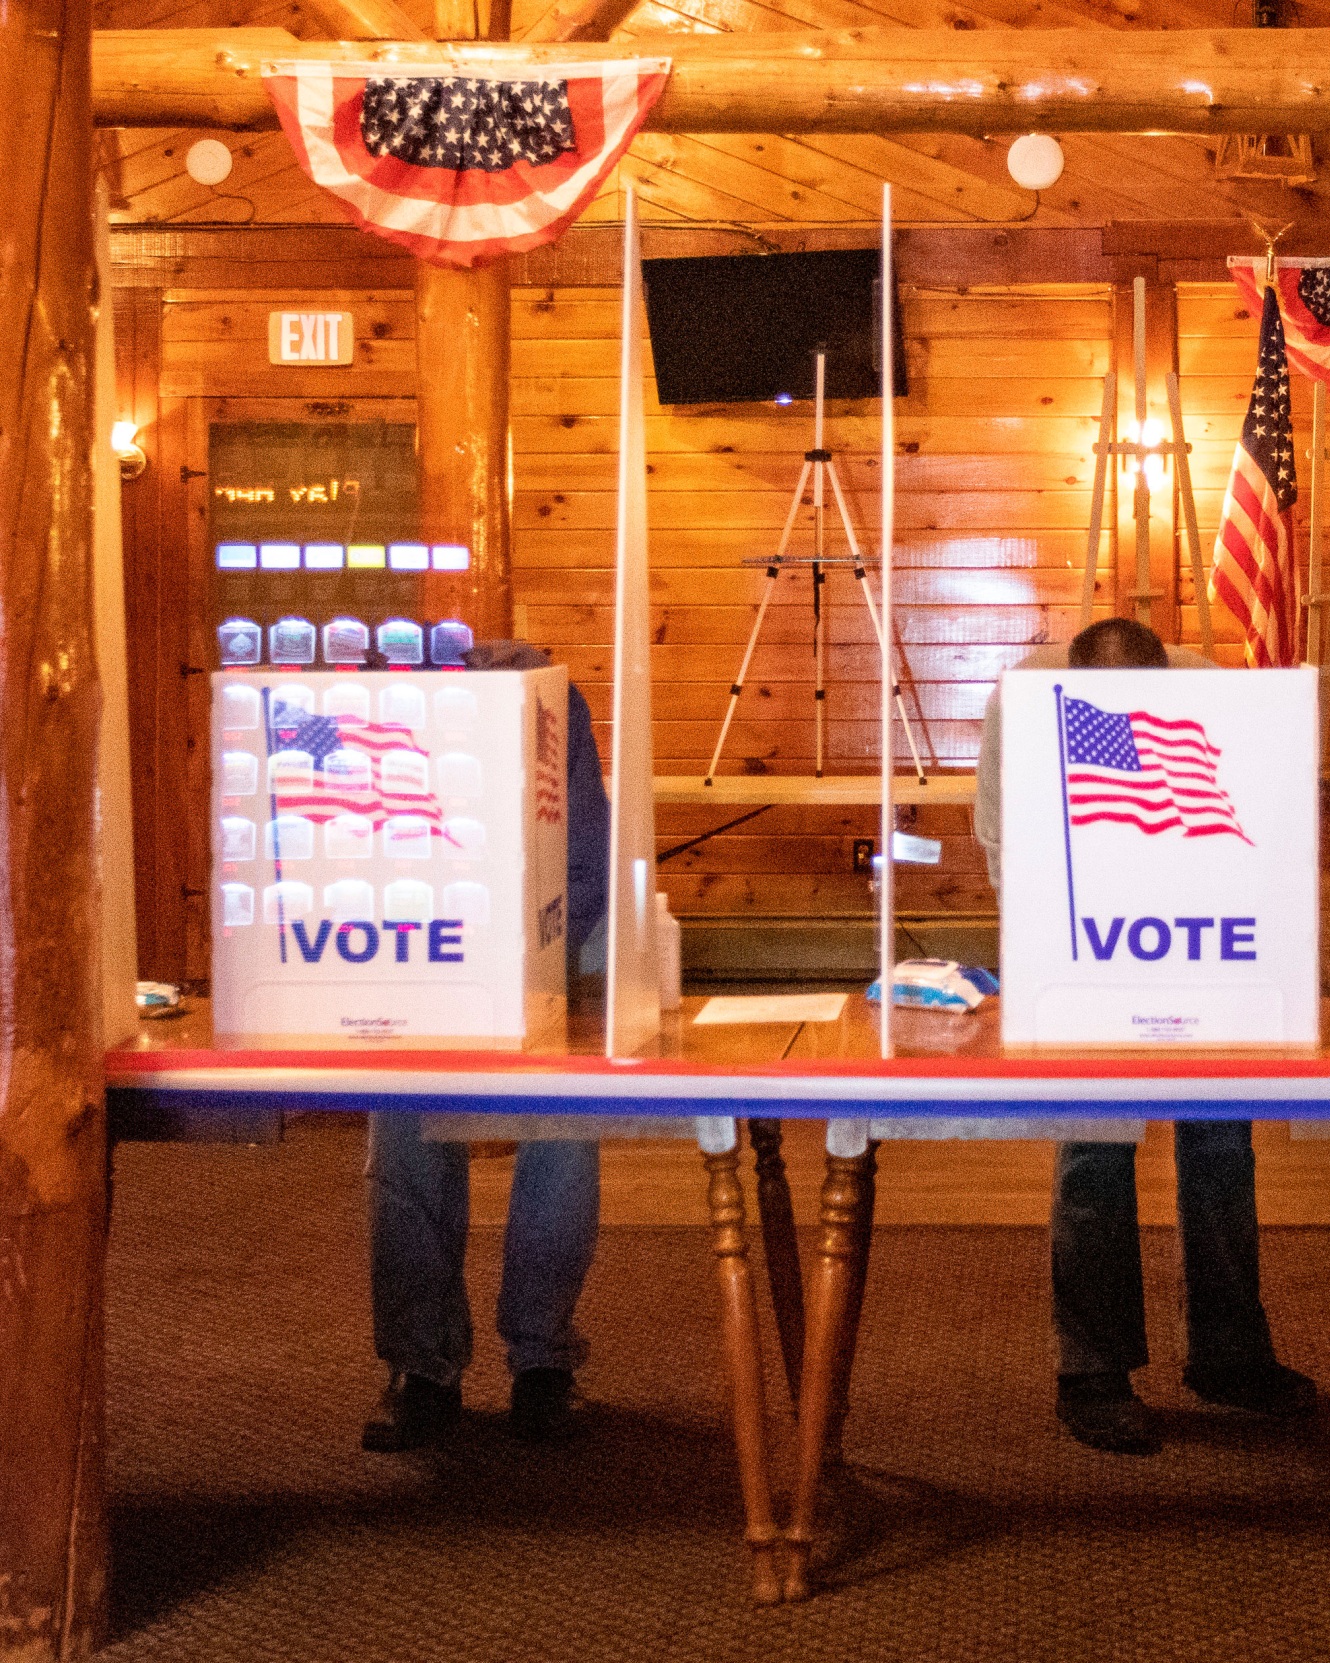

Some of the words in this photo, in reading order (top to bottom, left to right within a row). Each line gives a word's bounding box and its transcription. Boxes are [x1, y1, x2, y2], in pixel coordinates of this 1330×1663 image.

[280, 312, 343, 361] EXIT
[292, 919, 465, 963] VOTE
[1082, 917, 1257, 962] VOTE
